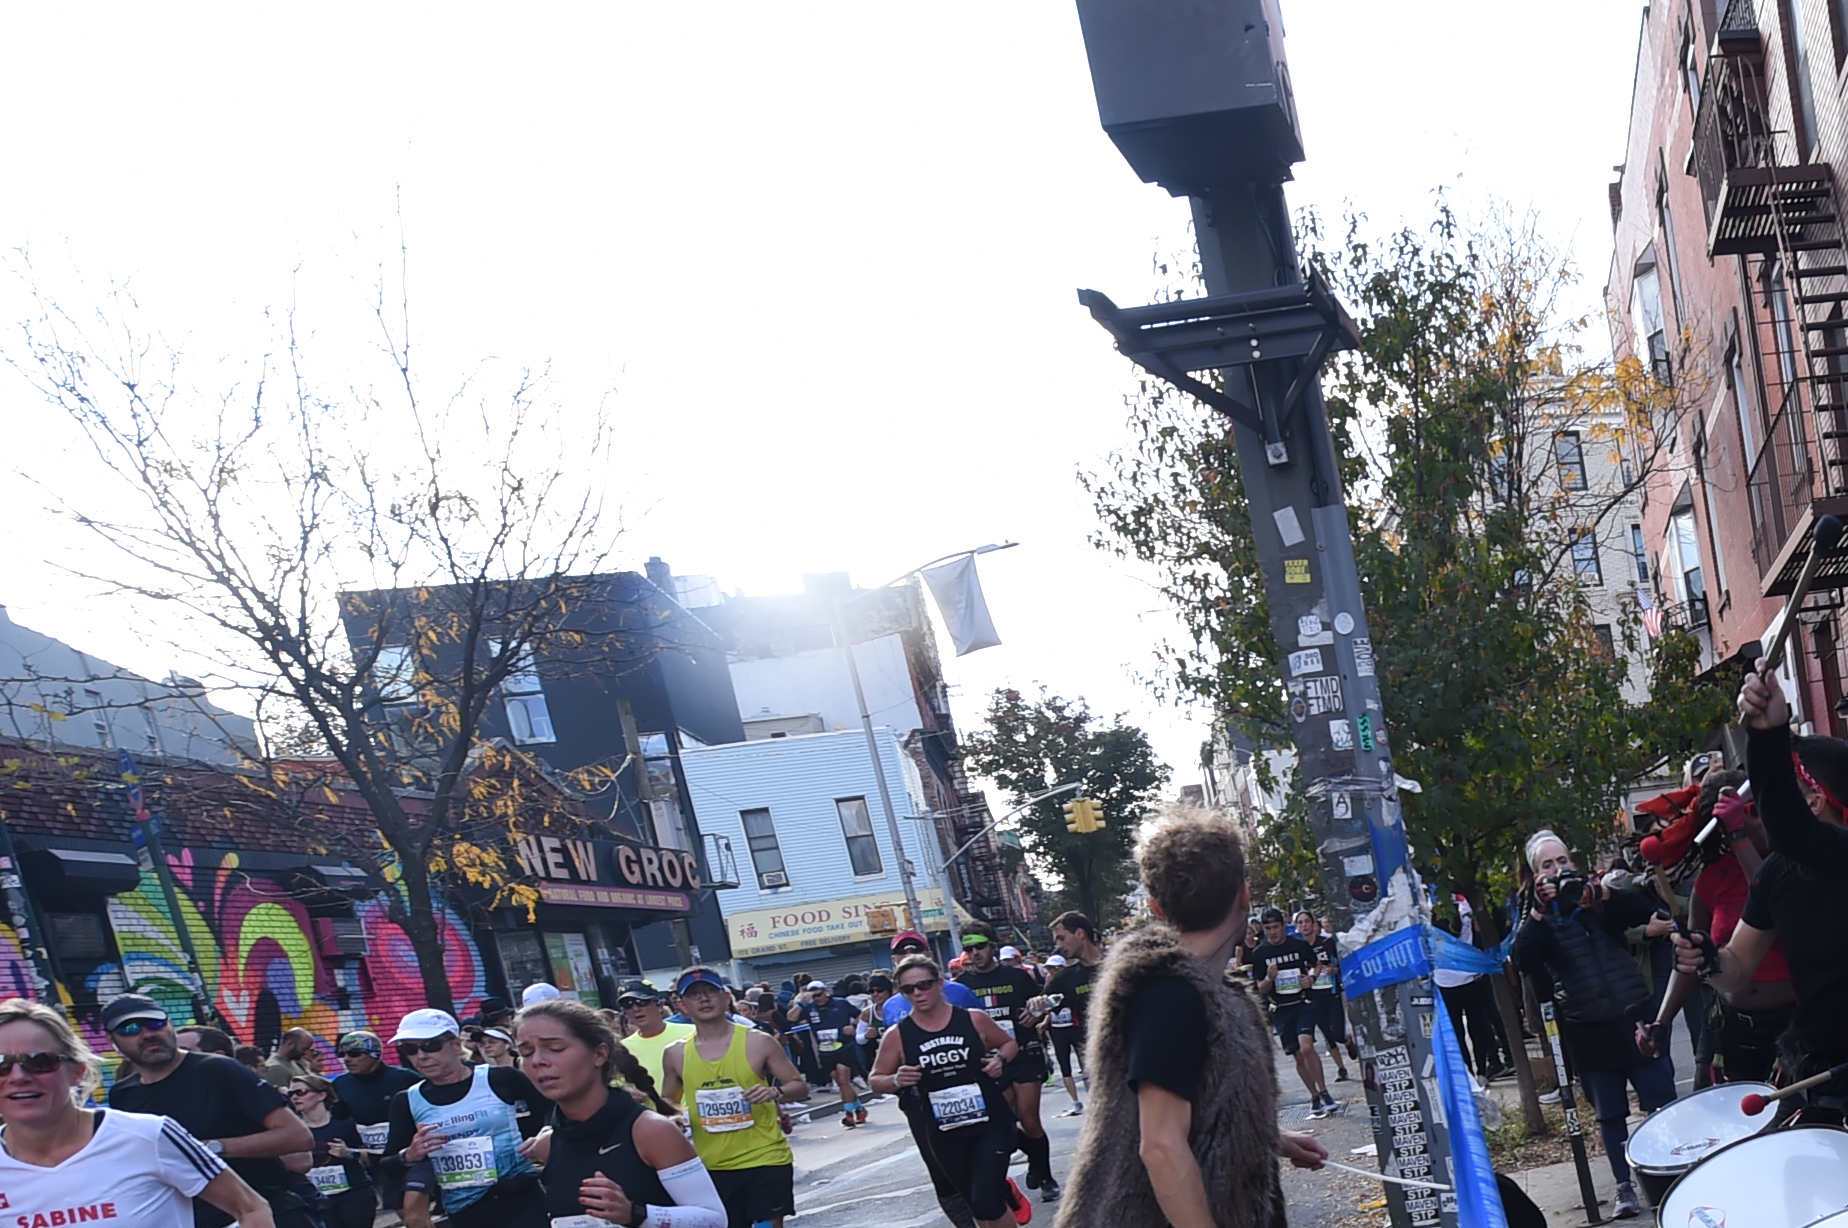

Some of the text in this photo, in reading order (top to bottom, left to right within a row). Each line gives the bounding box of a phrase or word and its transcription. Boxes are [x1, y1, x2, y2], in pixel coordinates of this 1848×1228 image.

[518, 835, 598, 881] NEW
[770, 909, 831, 930] FOOD
[768, 919, 864, 940] CHINESE FOOD TAKE OUT
[918, 1047, 970, 1069] PIGGY
[1385, 1080, 1409, 1093] STP
[706, 1101, 741, 1116] 29592
[941, 1098, 976, 1115] 22034
[1391, 1101, 1415, 1114] STP
[1395, 1123, 1419, 1136] STP
[1400, 1145, 1424, 1157] STP
[441, 1153, 483, 1172] 33853
[1404, 1166, 1428, 1178] STP
[1408, 1188, 1432, 1200] STP
[1412, 1210, 1436, 1221] STP
